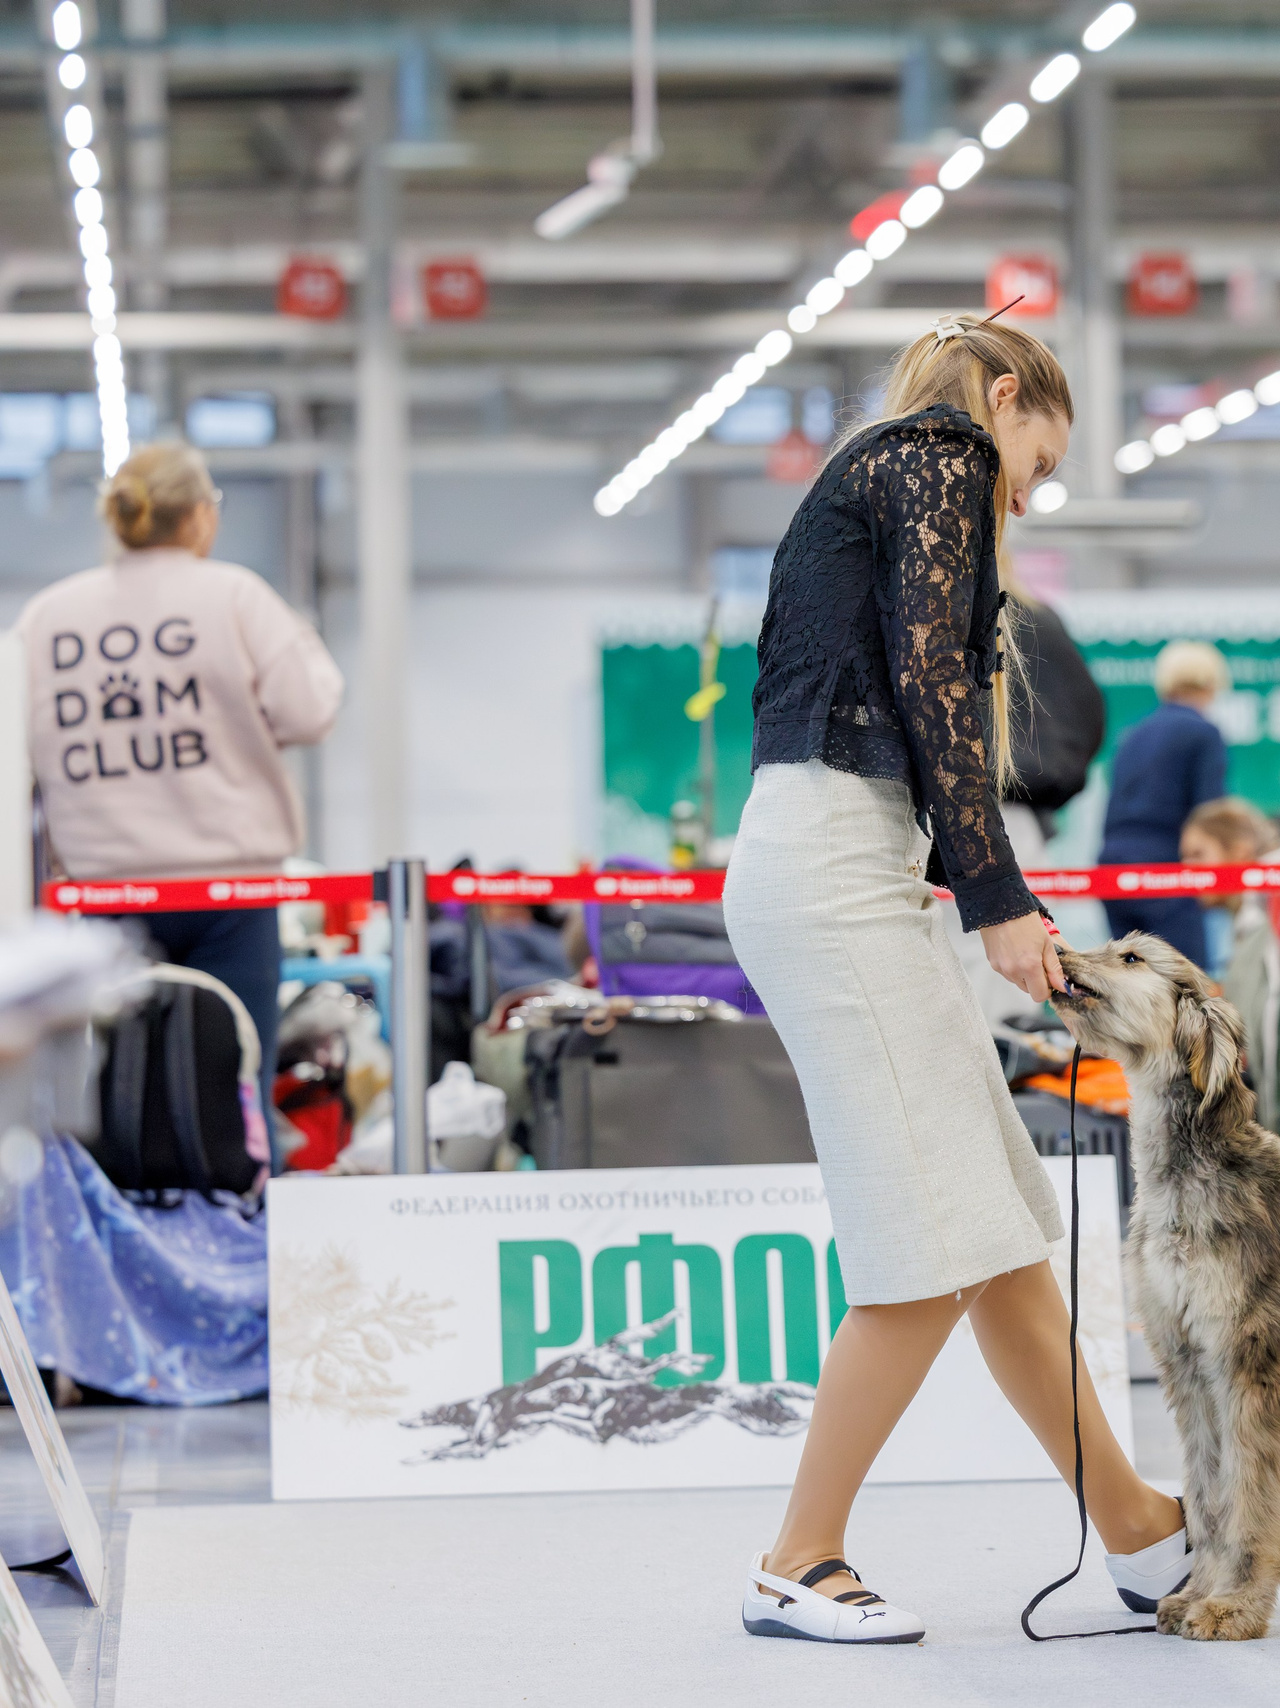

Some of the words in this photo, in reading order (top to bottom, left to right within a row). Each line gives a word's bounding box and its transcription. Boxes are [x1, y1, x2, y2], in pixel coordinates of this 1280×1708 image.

[53, 617, 196, 670] DOG
[62, 728, 209, 783] CLUB
[389, 1193, 552, 1217] ФЕДЕРАЦИЯ
[558, 1186, 756, 1211] ОХОТНИЧЬЕГО
